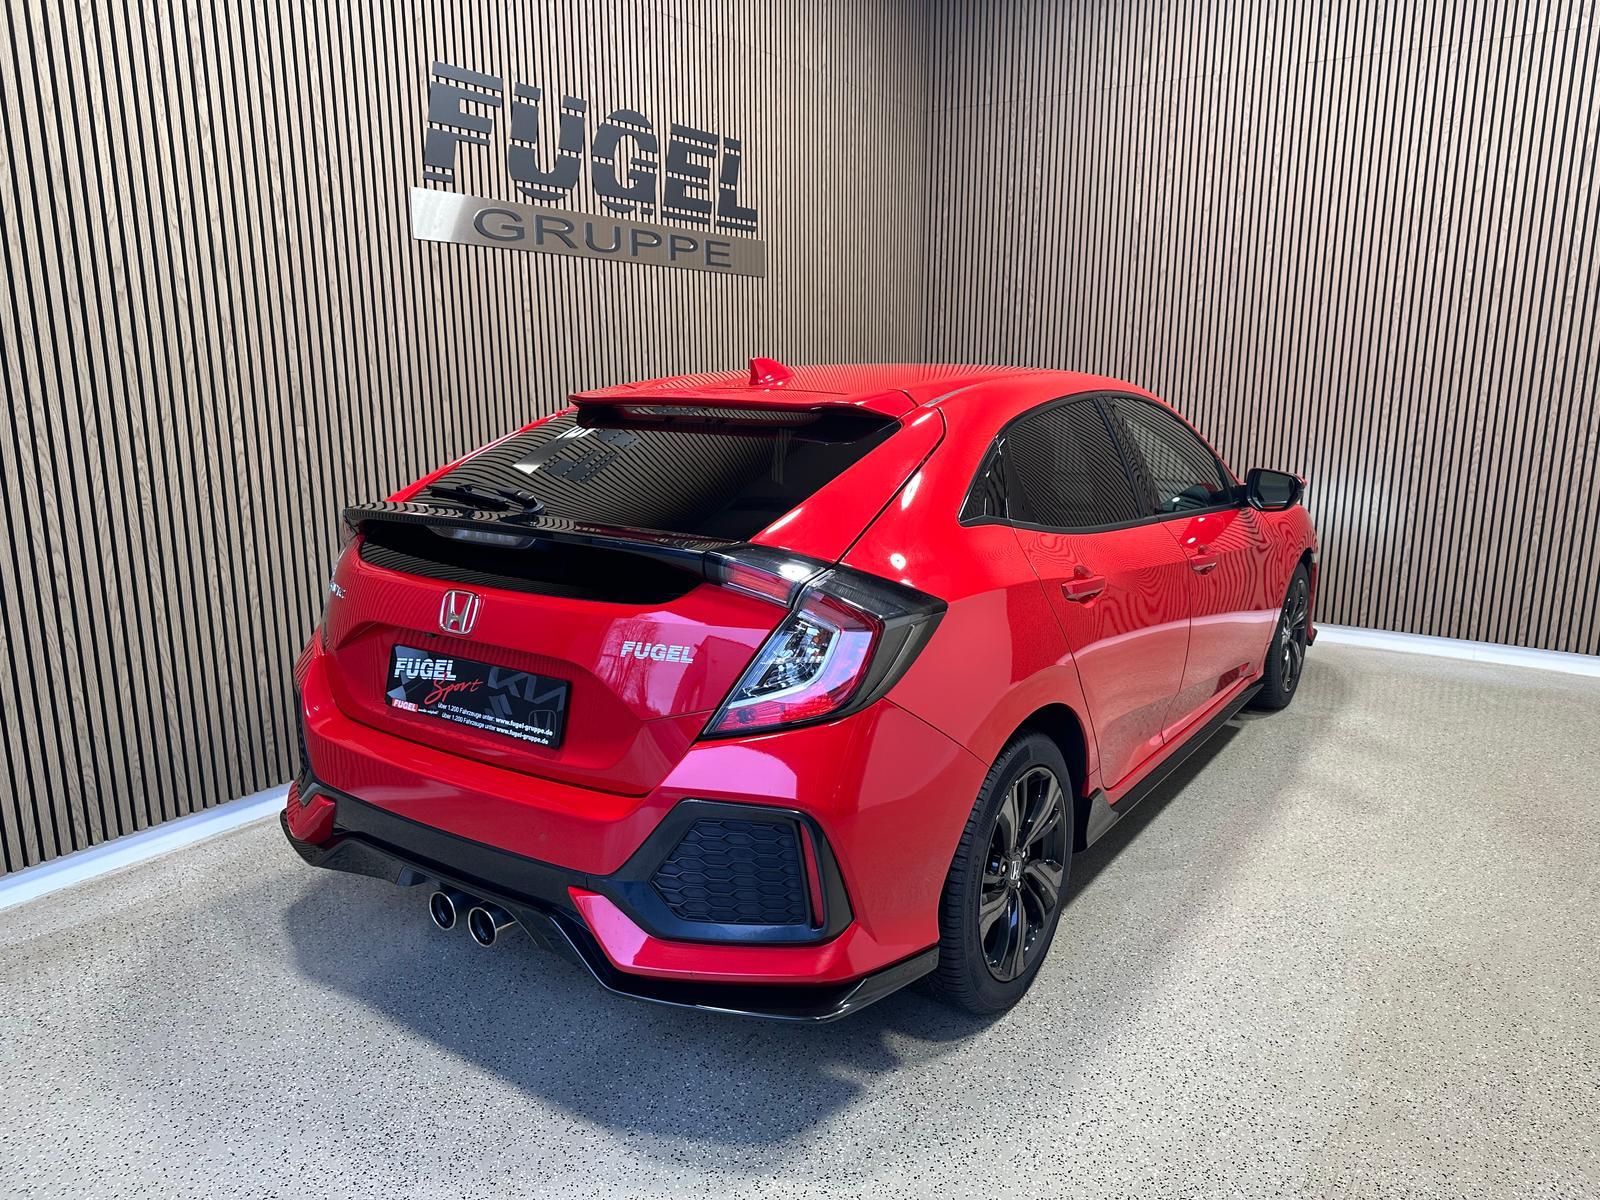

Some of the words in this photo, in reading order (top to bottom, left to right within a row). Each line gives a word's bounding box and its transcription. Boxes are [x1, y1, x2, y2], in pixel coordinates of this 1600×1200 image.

[423, 61, 757, 231] FUGEL
[473, 207, 732, 268] GRUPPE
[620, 640, 693, 664] FUGEL
[394, 658, 456, 680] FUGEL
[424, 673, 483, 704] Sport
[393, 699, 417, 712] FUGEL
[448, 704, 460, 713] 1.200
[460, 707, 482, 719] Fahrzeuge
[495, 717, 553, 736] www.fugel-gruppe.de
[451, 715, 463, 723] 1.200
[463, 717, 484, 728] Fahrzeuge
[496, 727, 549, 744] www.fugel-gruppe.de
